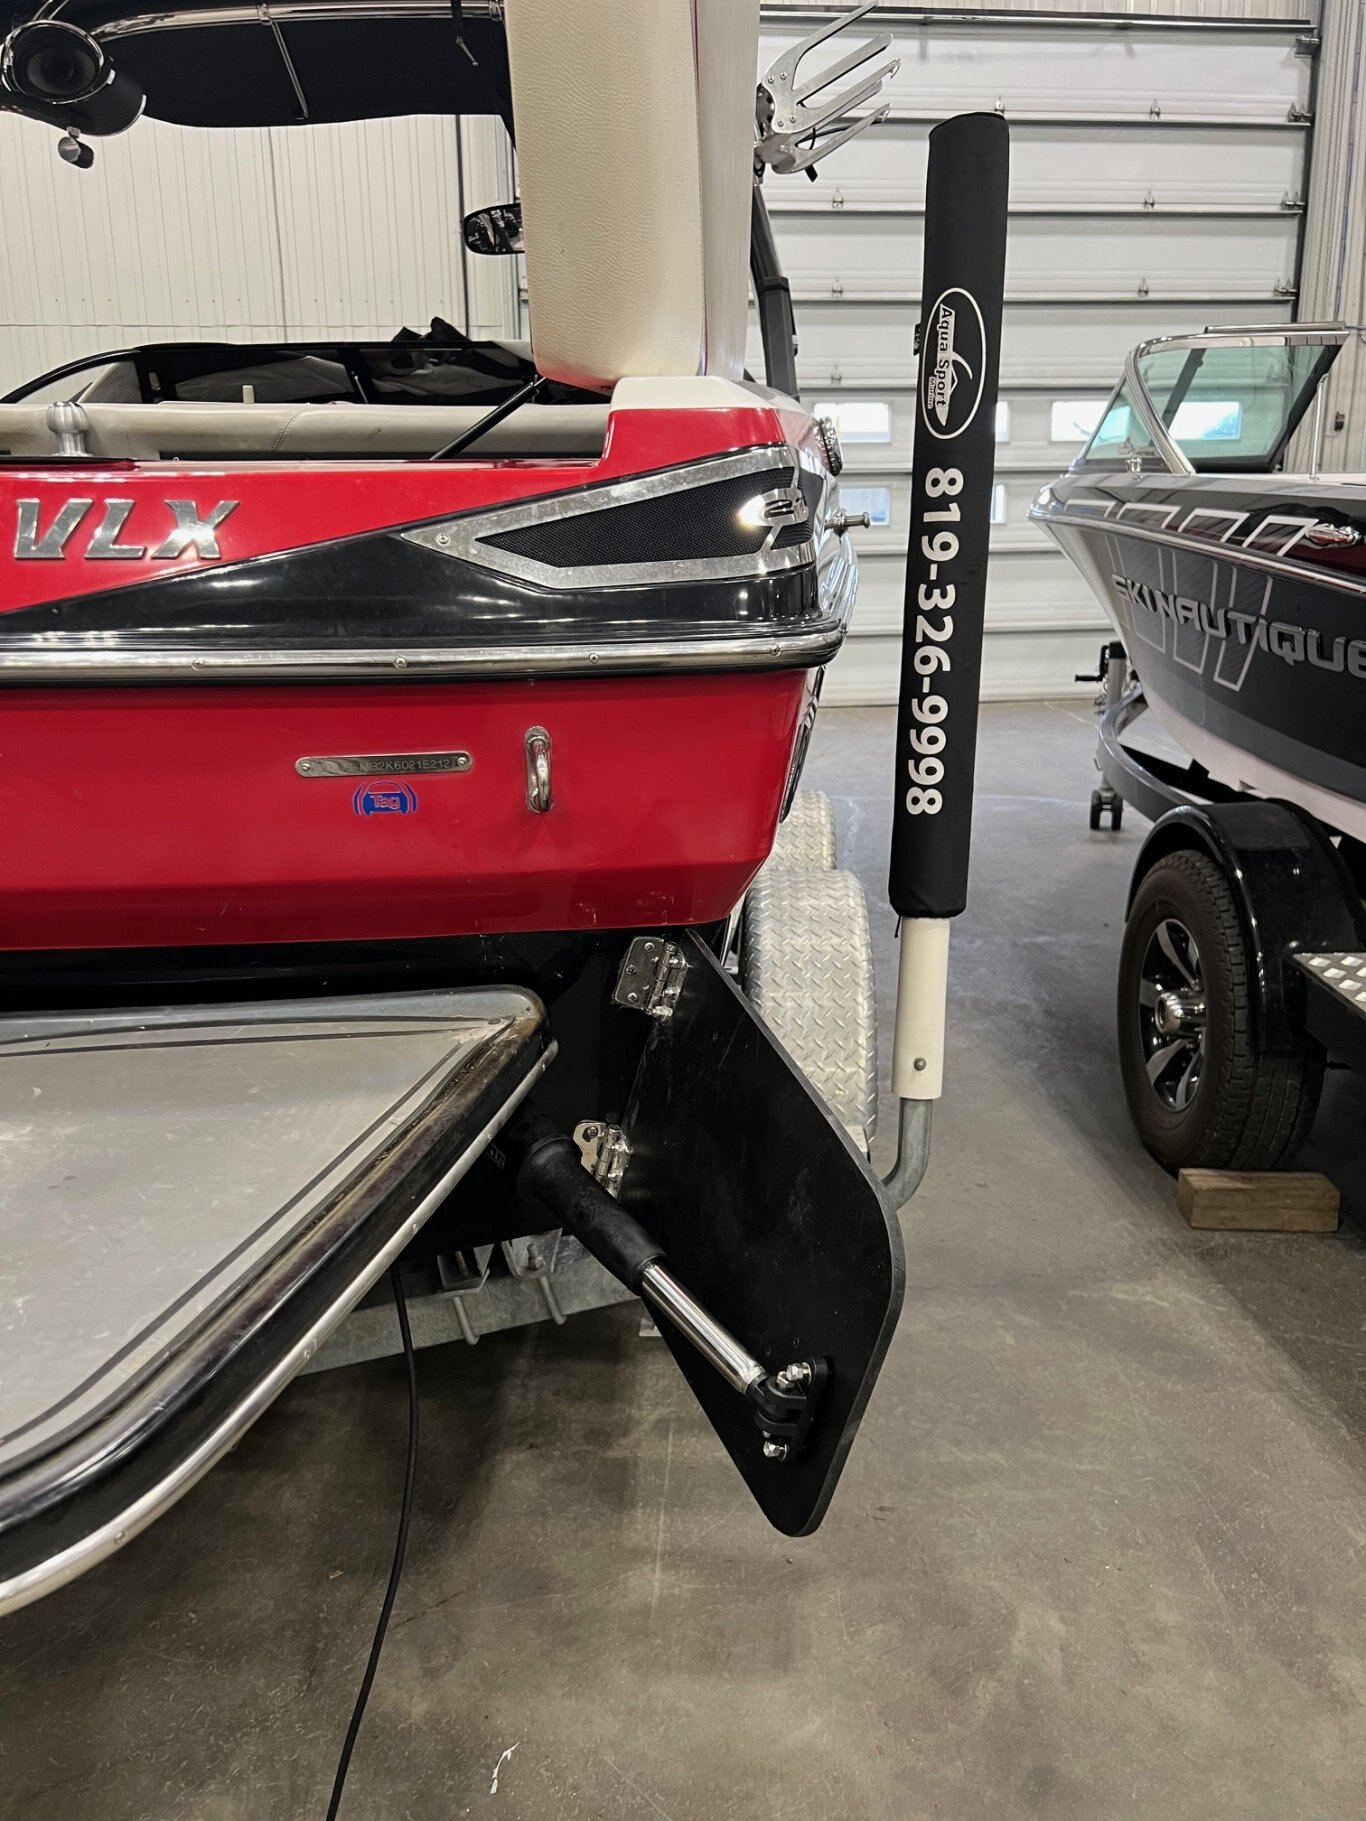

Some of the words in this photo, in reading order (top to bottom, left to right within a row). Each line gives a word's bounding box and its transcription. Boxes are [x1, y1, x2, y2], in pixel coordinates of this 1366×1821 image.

[938, 306, 953, 352] Aqua
[936, 358, 950, 407] Sport
[14, 498, 240, 560] VLX
[905, 467, 964, 816] 819-326-9998
[370, 795, 401, 810] Tag
